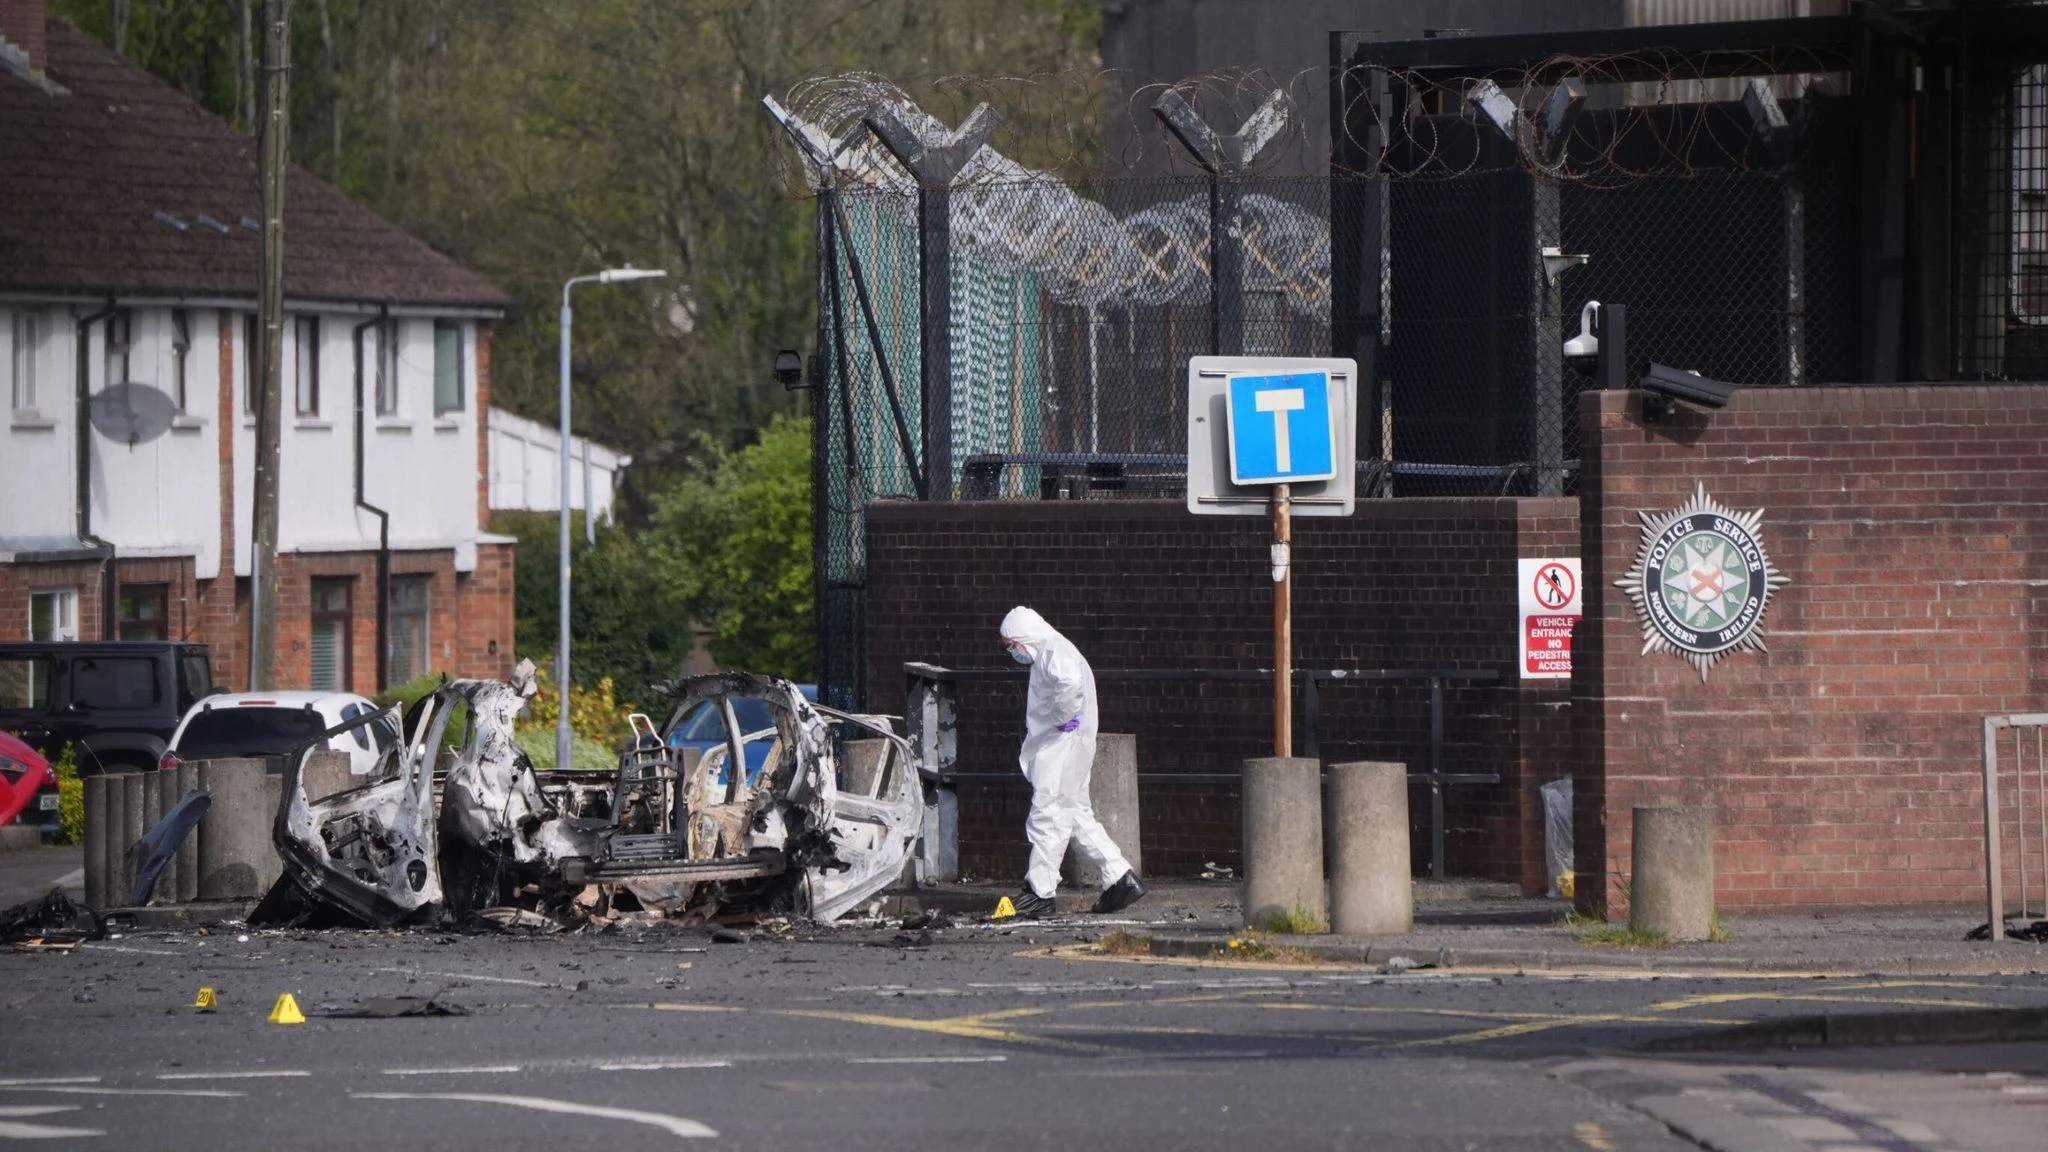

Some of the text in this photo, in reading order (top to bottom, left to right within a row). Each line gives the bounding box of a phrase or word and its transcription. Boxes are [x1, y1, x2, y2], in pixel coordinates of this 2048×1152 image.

[1650, 518, 1761, 573] POLICE SERVICE
[1536, 617, 1574, 627] VEHICLE
[1650, 590, 1758, 644] NORTHERN IRELAND
[1531, 628, 1573, 638] ENTRANC
[1547, 639, 1563, 649] NO
[1528, 650, 1571, 660] PEDESTRI
[1538, 661, 1573, 671] ACCESS
